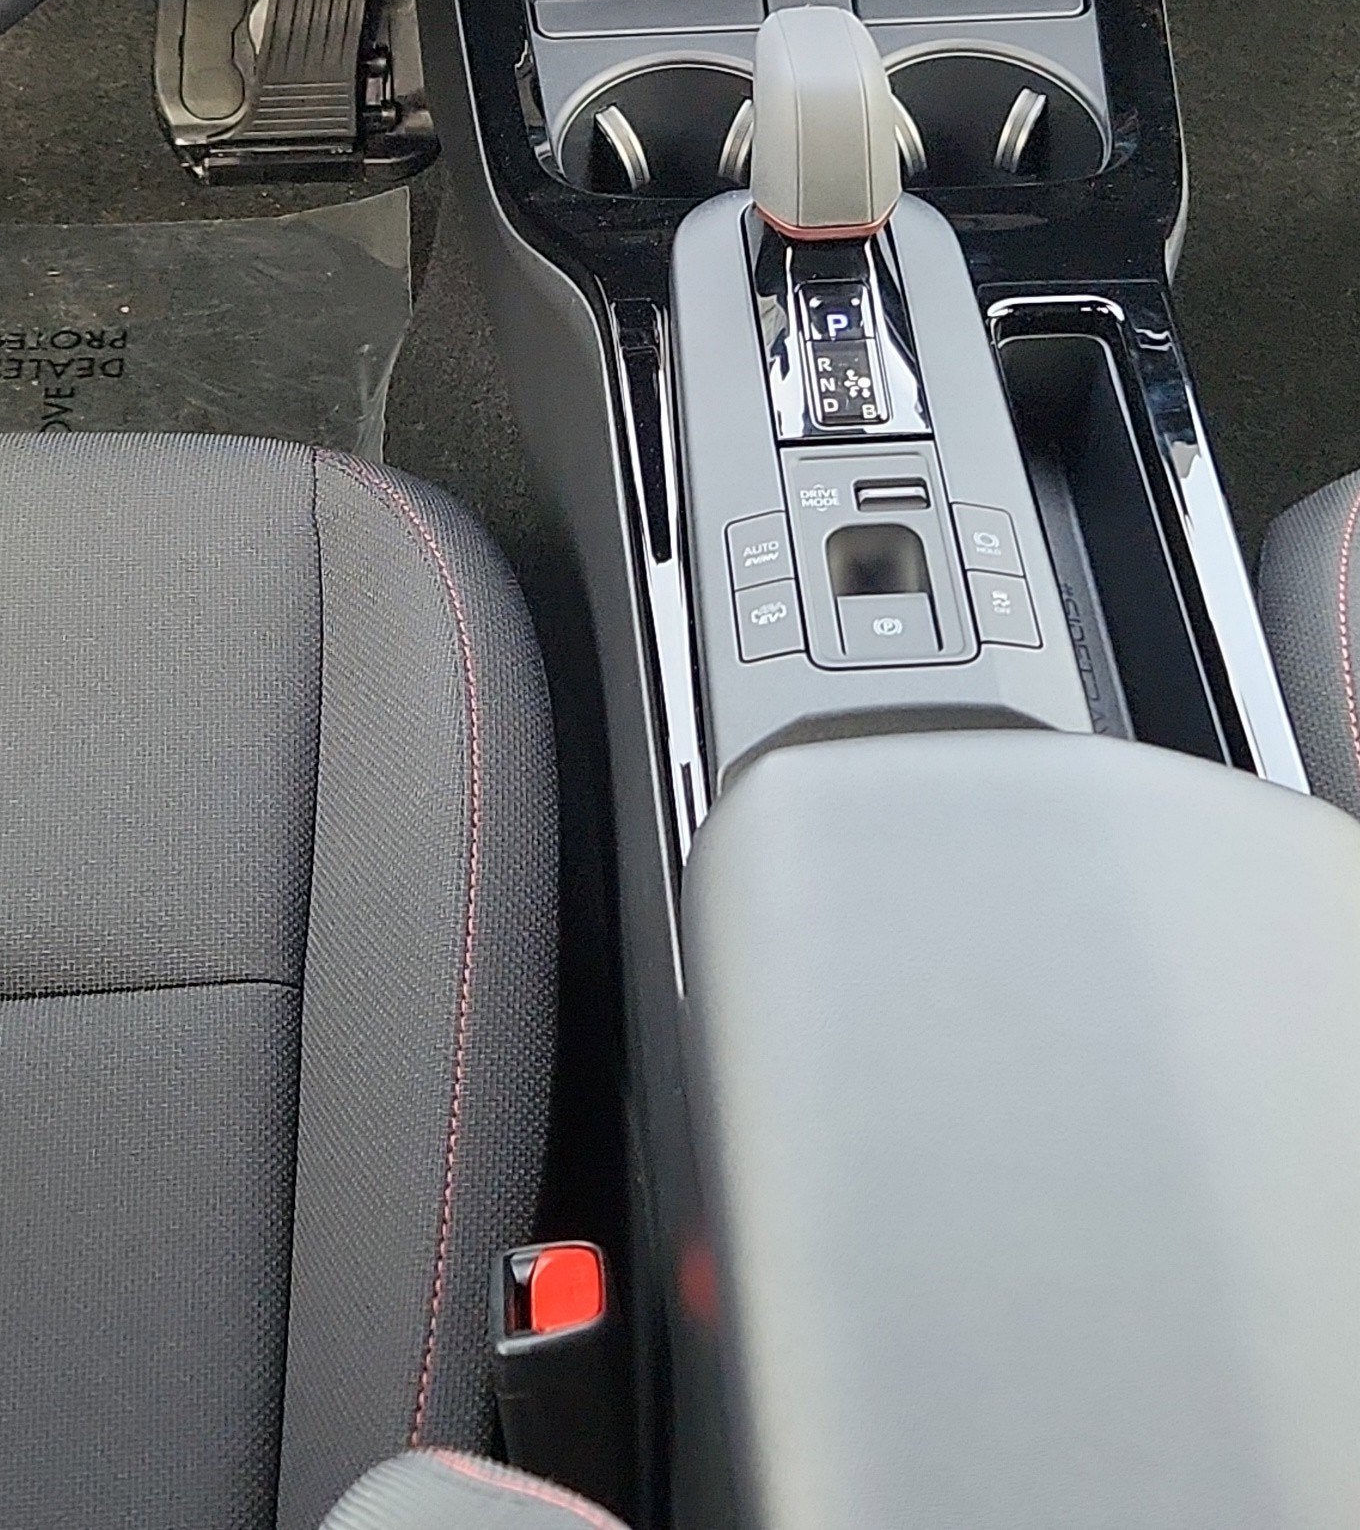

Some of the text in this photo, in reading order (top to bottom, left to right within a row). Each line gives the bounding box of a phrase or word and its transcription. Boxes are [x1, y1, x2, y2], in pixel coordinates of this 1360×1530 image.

[827, 314, 849, 337] P
[817, 357, 832, 372] R
[820, 377, 836, 392] N
[823, 398, 839, 413] D
[861, 403, 877, 419] B
[800, 489, 839, 500] DRIVE
[801, 497, 841, 507] MODE
[743, 540, 779, 557] AUTO
